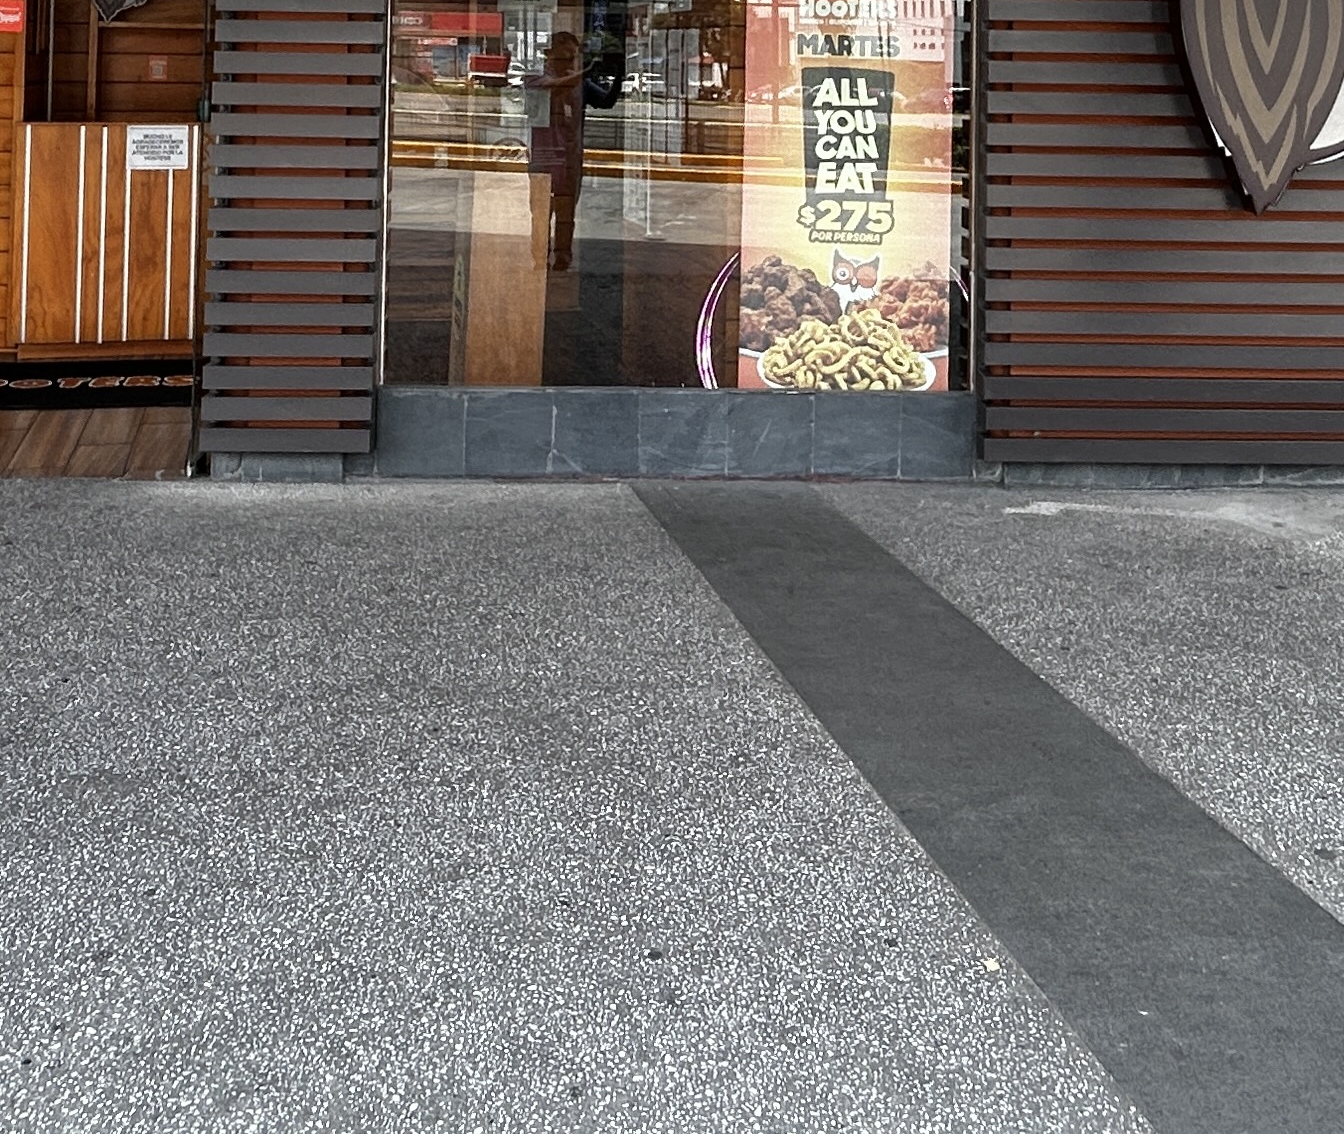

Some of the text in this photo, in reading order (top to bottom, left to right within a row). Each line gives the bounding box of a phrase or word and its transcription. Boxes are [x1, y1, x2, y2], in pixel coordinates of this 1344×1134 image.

[797, 34, 900, 57] MARTES
[813, 78, 878, 106] ALL
[814, 109, 876, 135] YOU
[815, 135, 879, 160] CAN
[815, 162, 878, 194] EAT
[799, 199, 893, 233] $275
[810, 231, 881, 244] POR PERSONA
